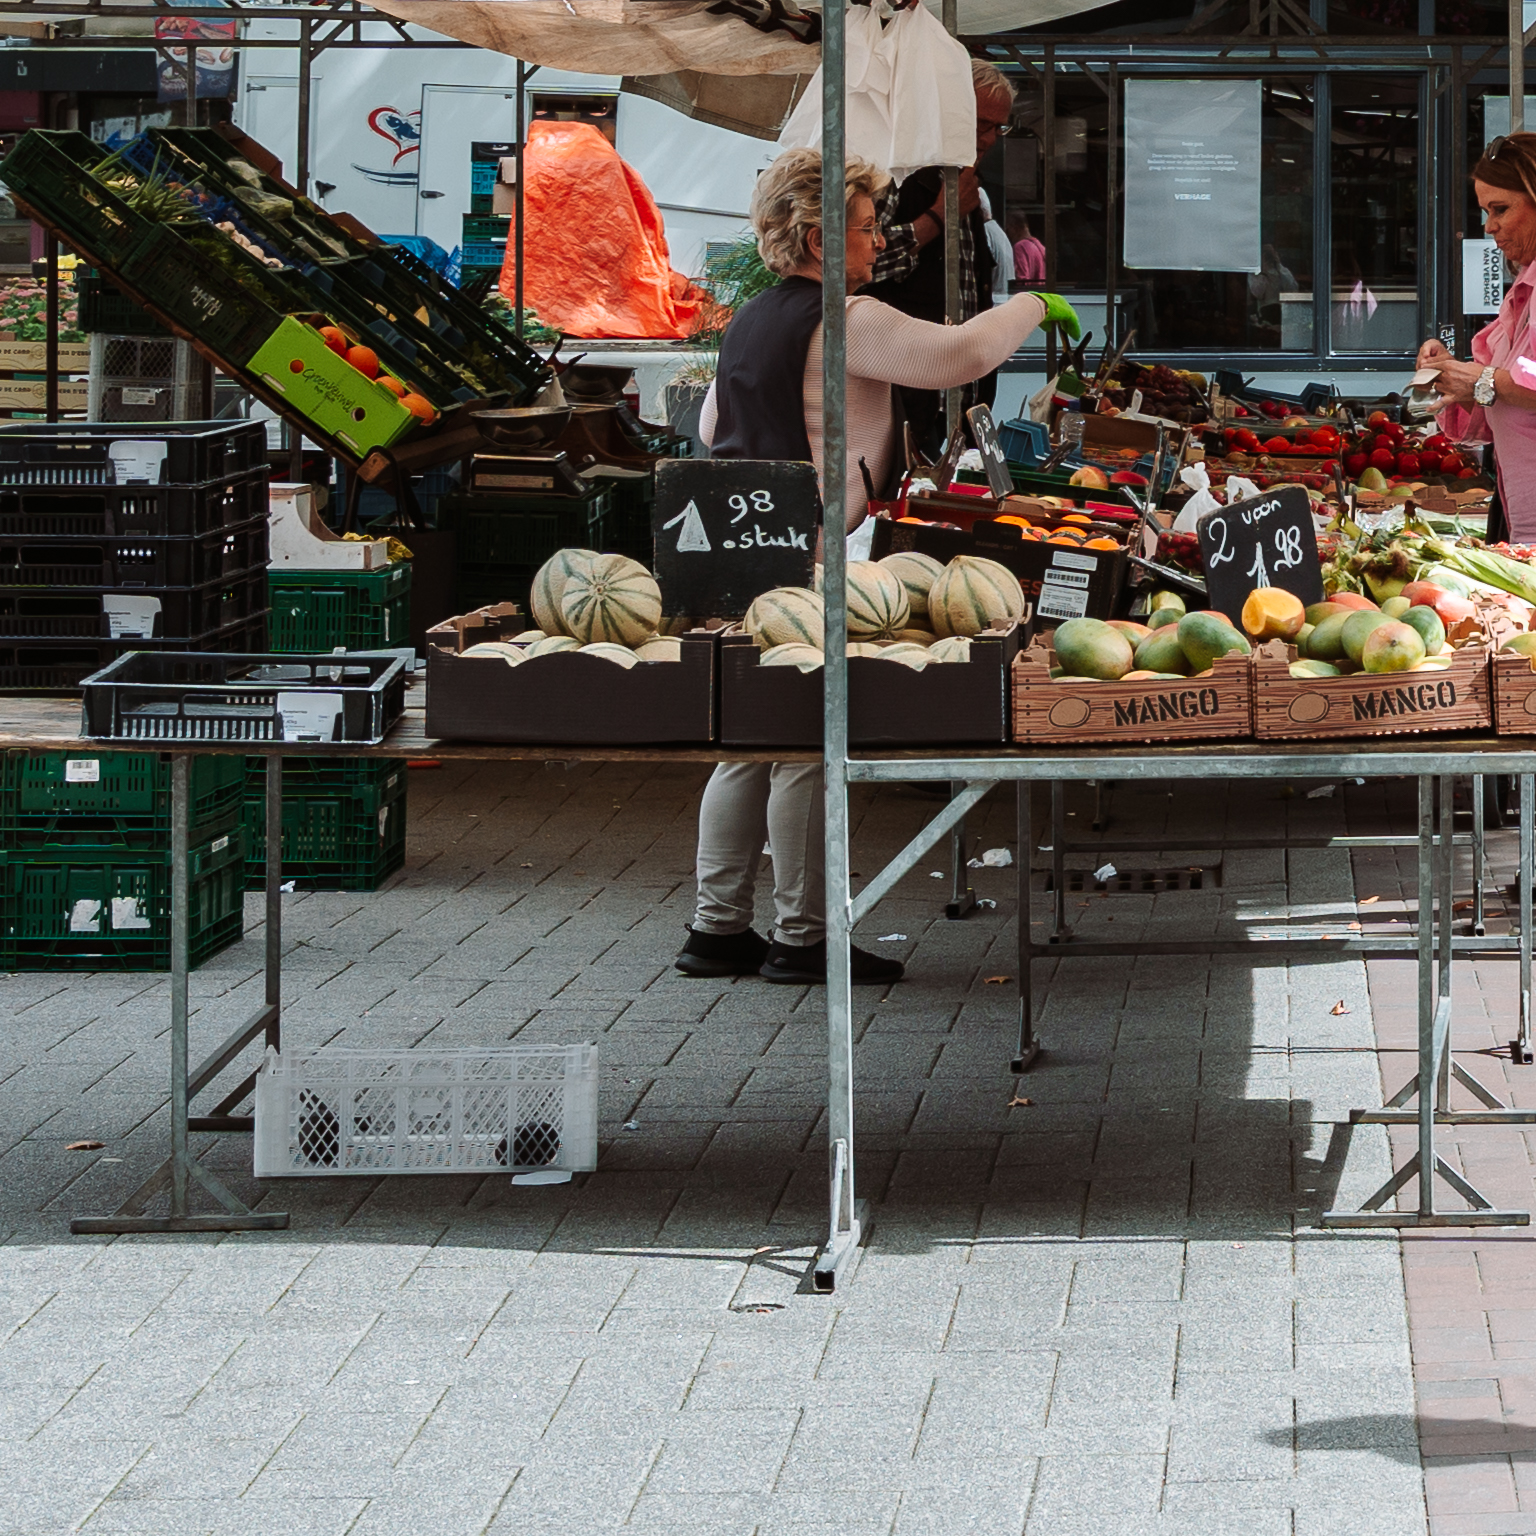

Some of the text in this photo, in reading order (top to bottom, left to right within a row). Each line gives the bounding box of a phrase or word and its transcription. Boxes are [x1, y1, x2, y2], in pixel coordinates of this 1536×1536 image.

[1491, 247, 1501, 281] VOOR
[728, 490, 775, 524] 98
[1208, 517, 1235, 568] 2
[1274, 525, 1303, 572] 98
[1113, 688, 1220, 727] MANGO
[1351, 681, 1457, 722] MANGO
